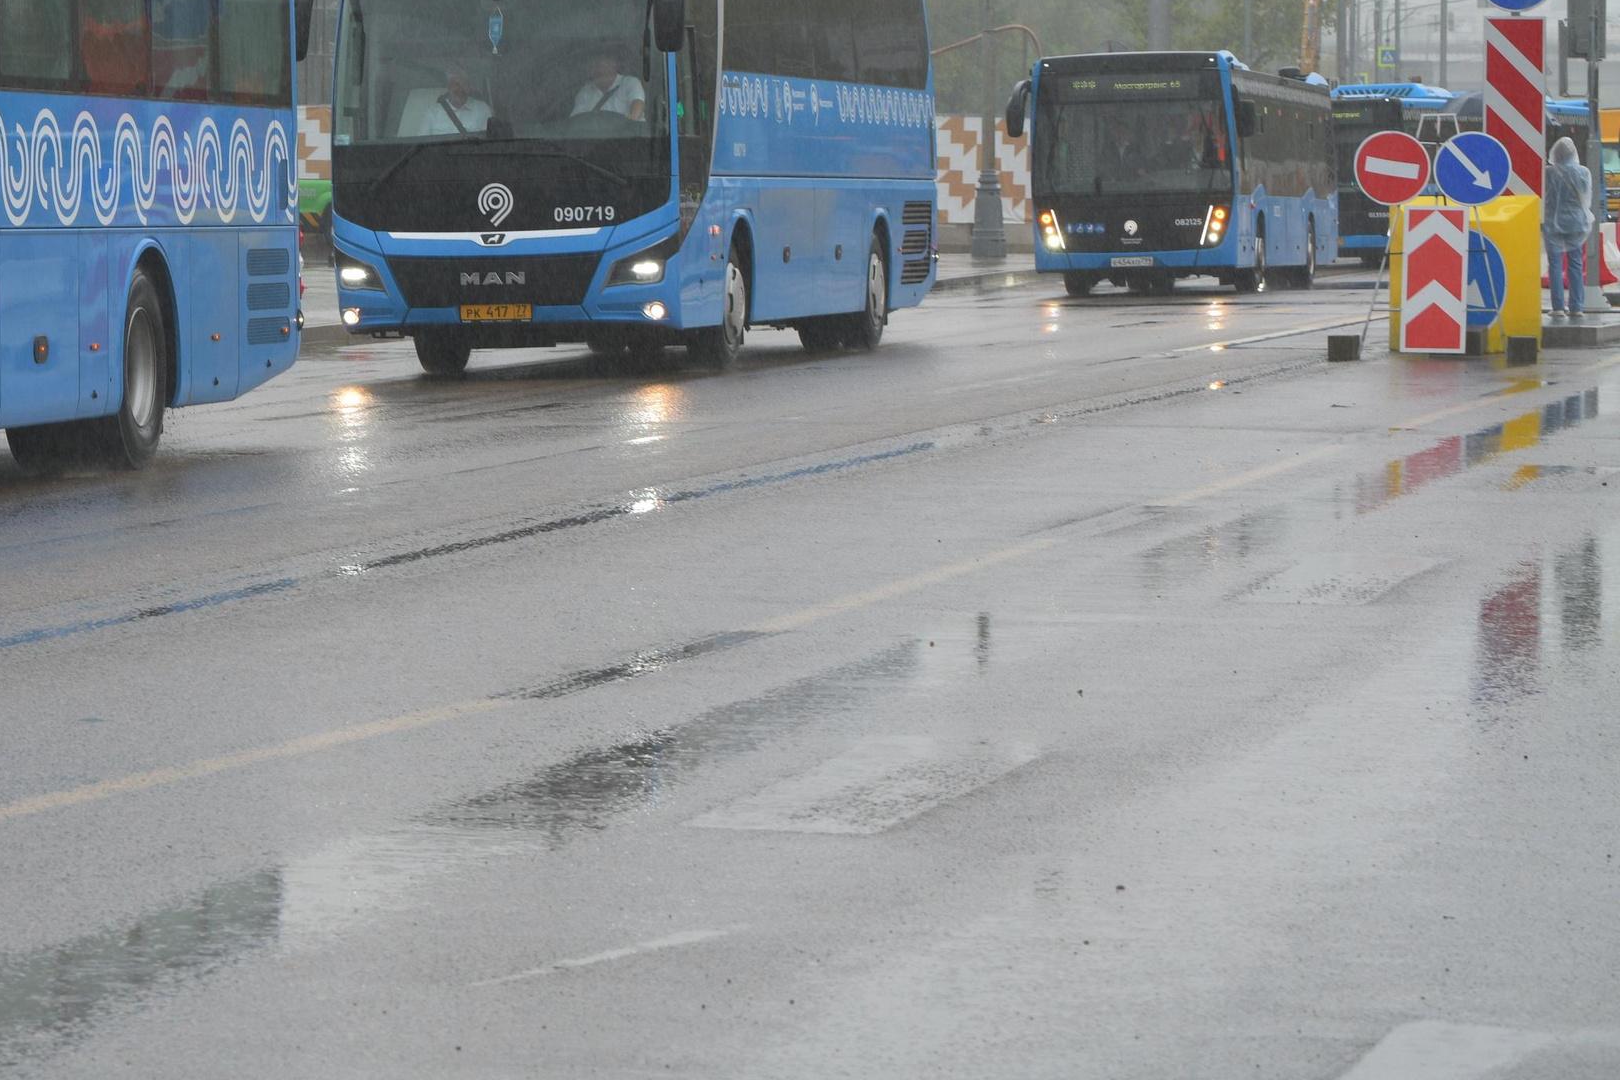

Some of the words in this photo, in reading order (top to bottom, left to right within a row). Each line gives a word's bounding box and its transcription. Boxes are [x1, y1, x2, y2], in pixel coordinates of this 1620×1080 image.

[553, 206, 615, 222] 090719
[460, 271, 526, 286] MAN
[486, 304, 509, 317] 417
